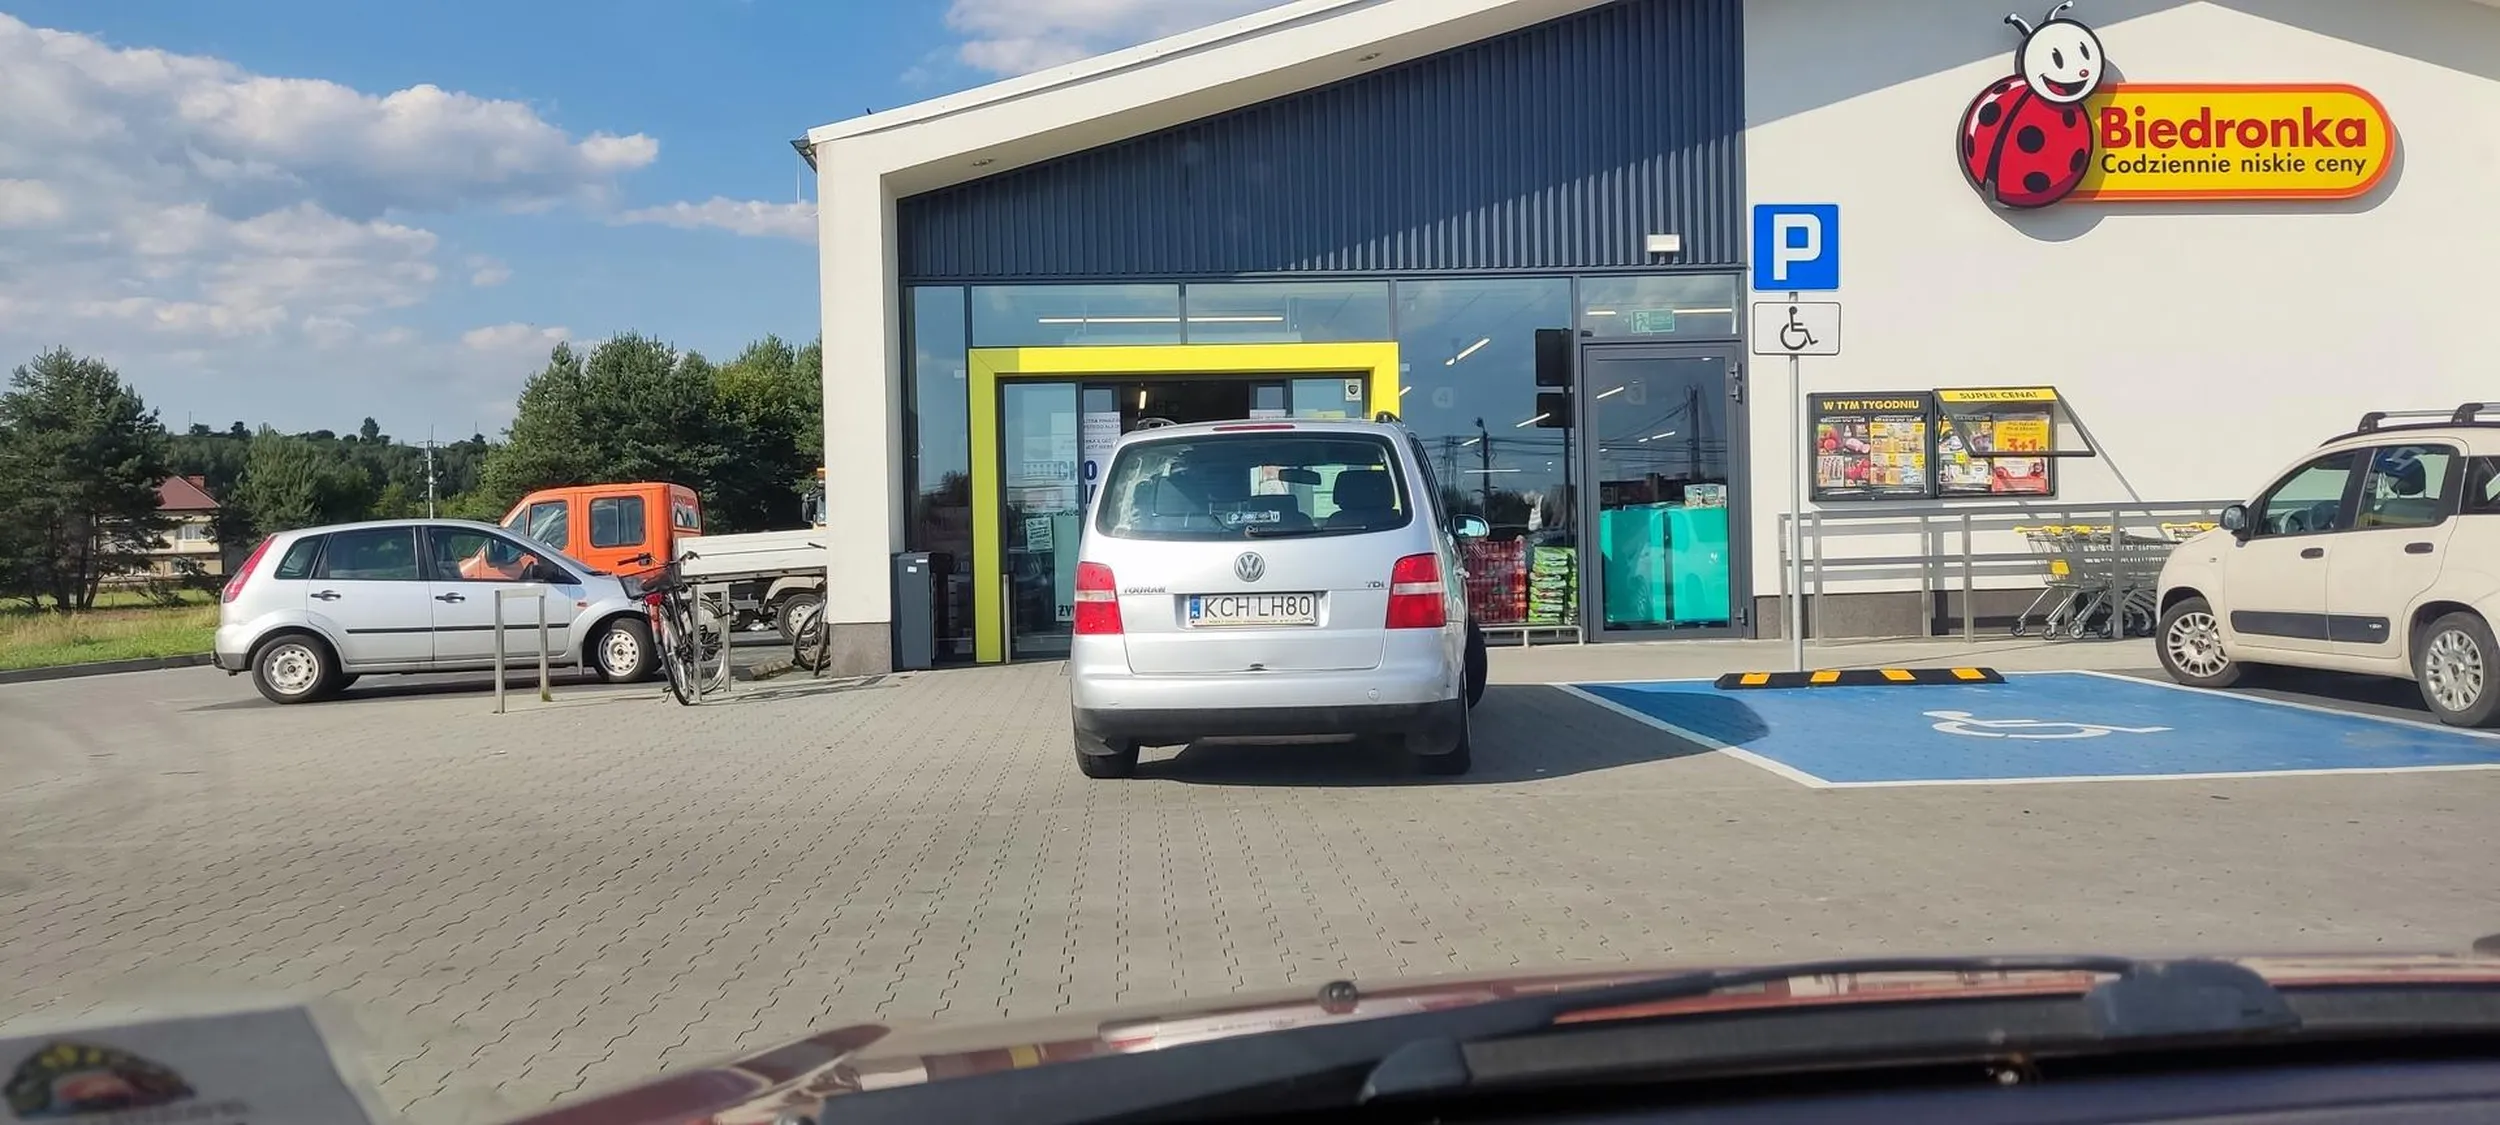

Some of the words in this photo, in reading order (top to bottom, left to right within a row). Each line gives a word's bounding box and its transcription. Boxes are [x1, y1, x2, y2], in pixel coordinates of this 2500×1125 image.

[2101, 106, 2366, 149] Biedronka
[2101, 153, 2231, 174] Codziennie
[2241, 152, 2305, 173] niskie
[2315, 158, 2366, 176] ceny
[1773, 213, 1821, 280] P
[1823, 401, 1834, 410] W
[1837, 401, 1860, 409] TYM
[1862, 400, 1920, 409] TYGODNIU
[1959, 391, 1998, 399] SUPER
[2000, 391, 2038, 399] CENA!
[1204, 596, 1250, 618] KCH
[1258, 596, 1311, 616] LH80
